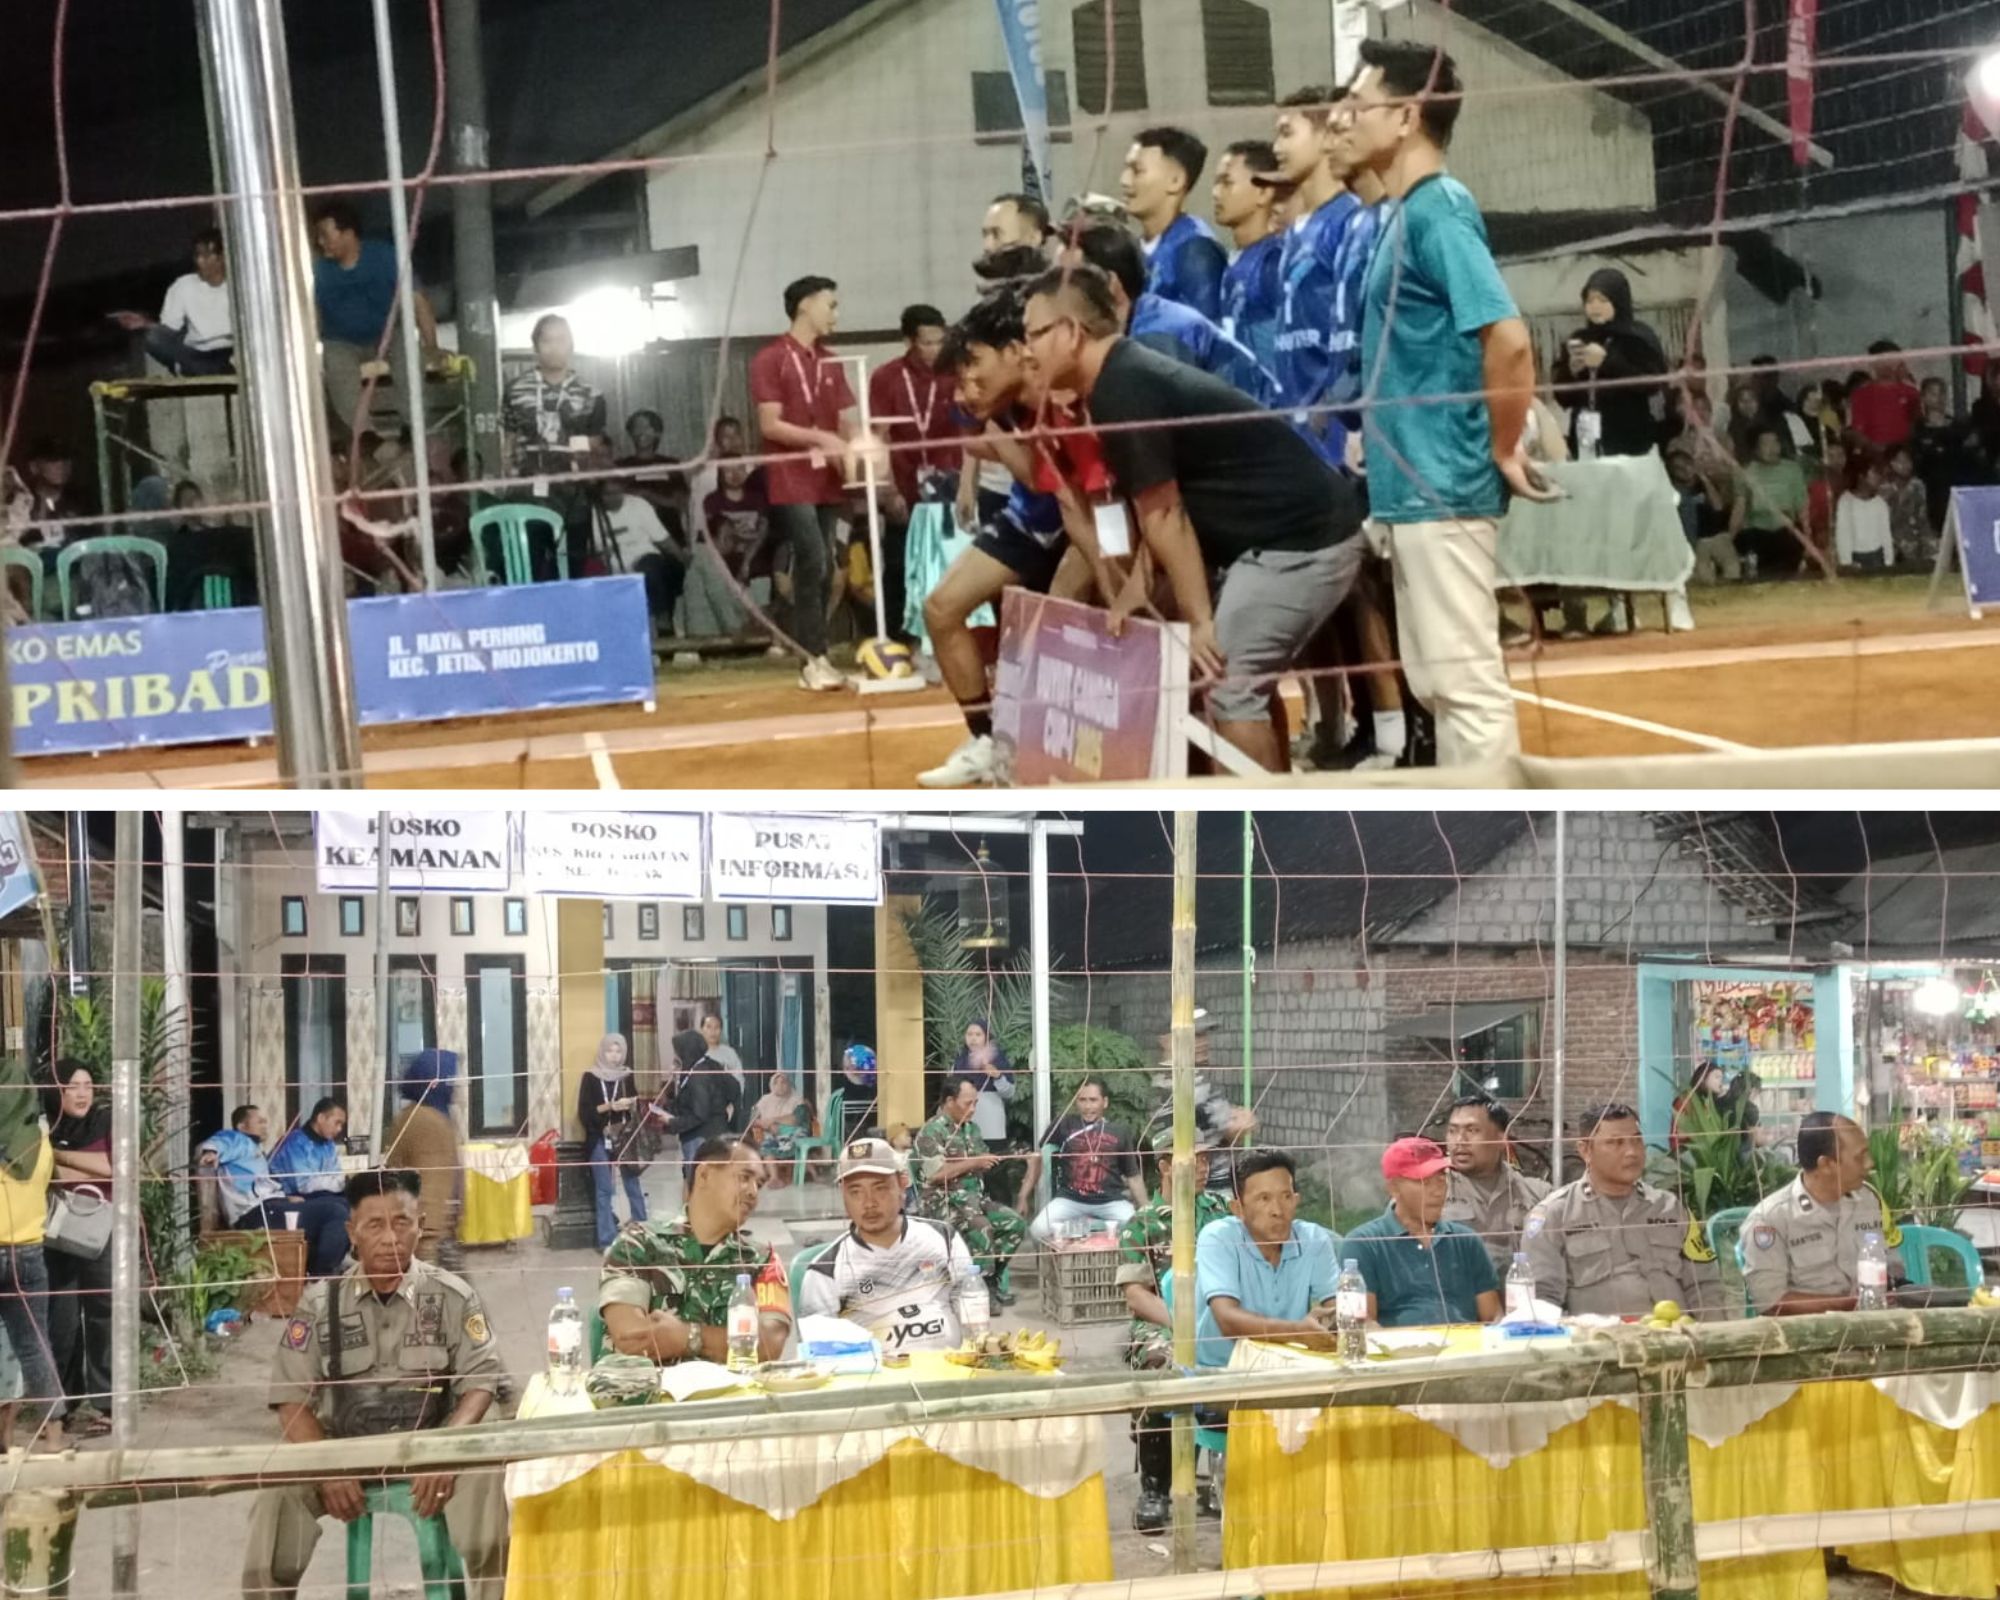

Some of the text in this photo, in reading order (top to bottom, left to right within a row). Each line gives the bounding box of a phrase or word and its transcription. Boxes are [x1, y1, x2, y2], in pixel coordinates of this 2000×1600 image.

[57, 630, 142, 660] EMAS
[417, 630, 463, 654] RAYA
[468, 623, 546, 648] PERNING
[389, 656, 429, 679] KEC.
[492, 641, 599, 670] MOJOKERTO
[12, 667, 272, 728] PRIBAD
